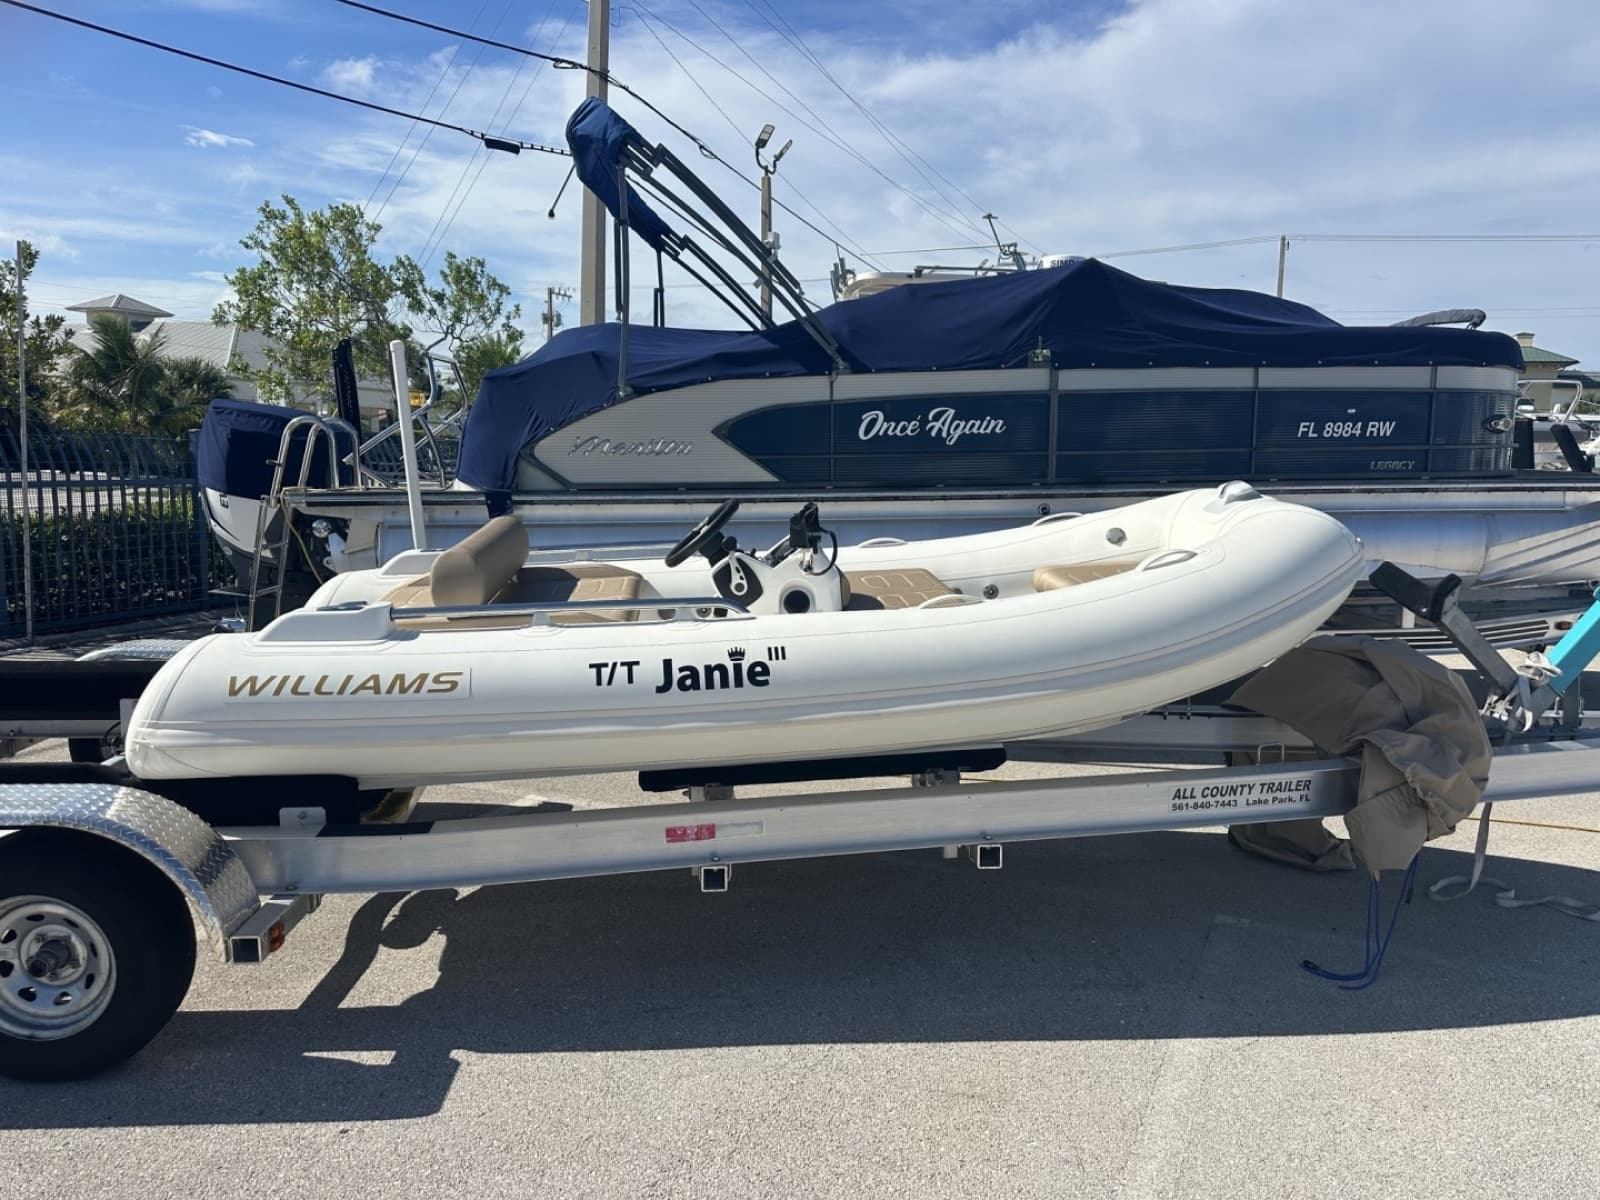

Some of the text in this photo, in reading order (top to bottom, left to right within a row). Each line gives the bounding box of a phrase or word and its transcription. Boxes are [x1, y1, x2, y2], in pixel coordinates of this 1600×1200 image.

[926, 407, 1006, 446] Again
[1298, 421, 1396, 438] FL 8984 RW
[568, 435, 693, 456] Manitou
[1369, 460, 1416, 471] LEGACY
[228, 672, 464, 697] WILLIAMS
[589, 660, 640, 687] T/T
[655, 658, 771, 694] Janie
[1172, 779, 1312, 800] ALL COUNTY TRAILER
[1171, 800, 1238, 811] 561-840-7443
[1246, 797, 1269, 806] Lake
[1300, 793, 1312, 802] FL
